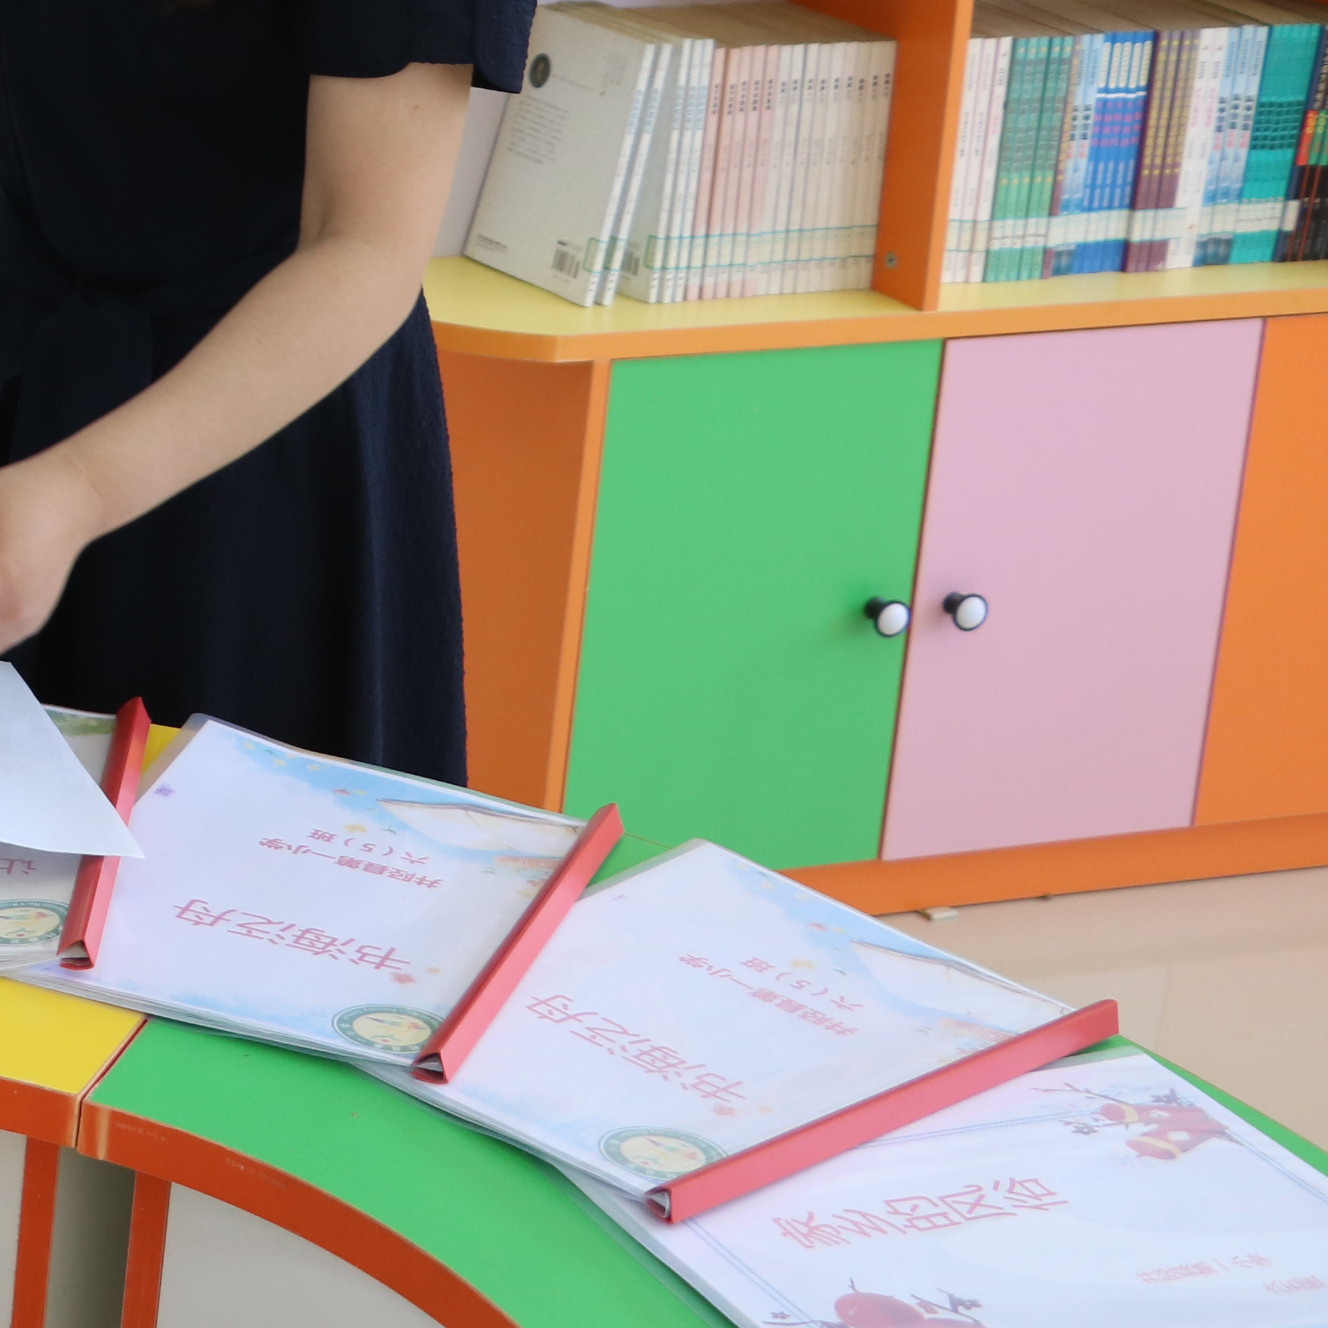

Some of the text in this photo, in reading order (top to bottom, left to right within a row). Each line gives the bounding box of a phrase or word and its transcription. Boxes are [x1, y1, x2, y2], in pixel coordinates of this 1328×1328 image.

[258, 834, 442, 890] 井陉县第一小学
[171, 897, 410, 972] 书海泛舟
[676, 949, 858, 1037] 井陉县第一小学
[521, 991, 745, 1111] 书海泛舟
[773, 1173, 1069, 1250] 家乡的风俗
